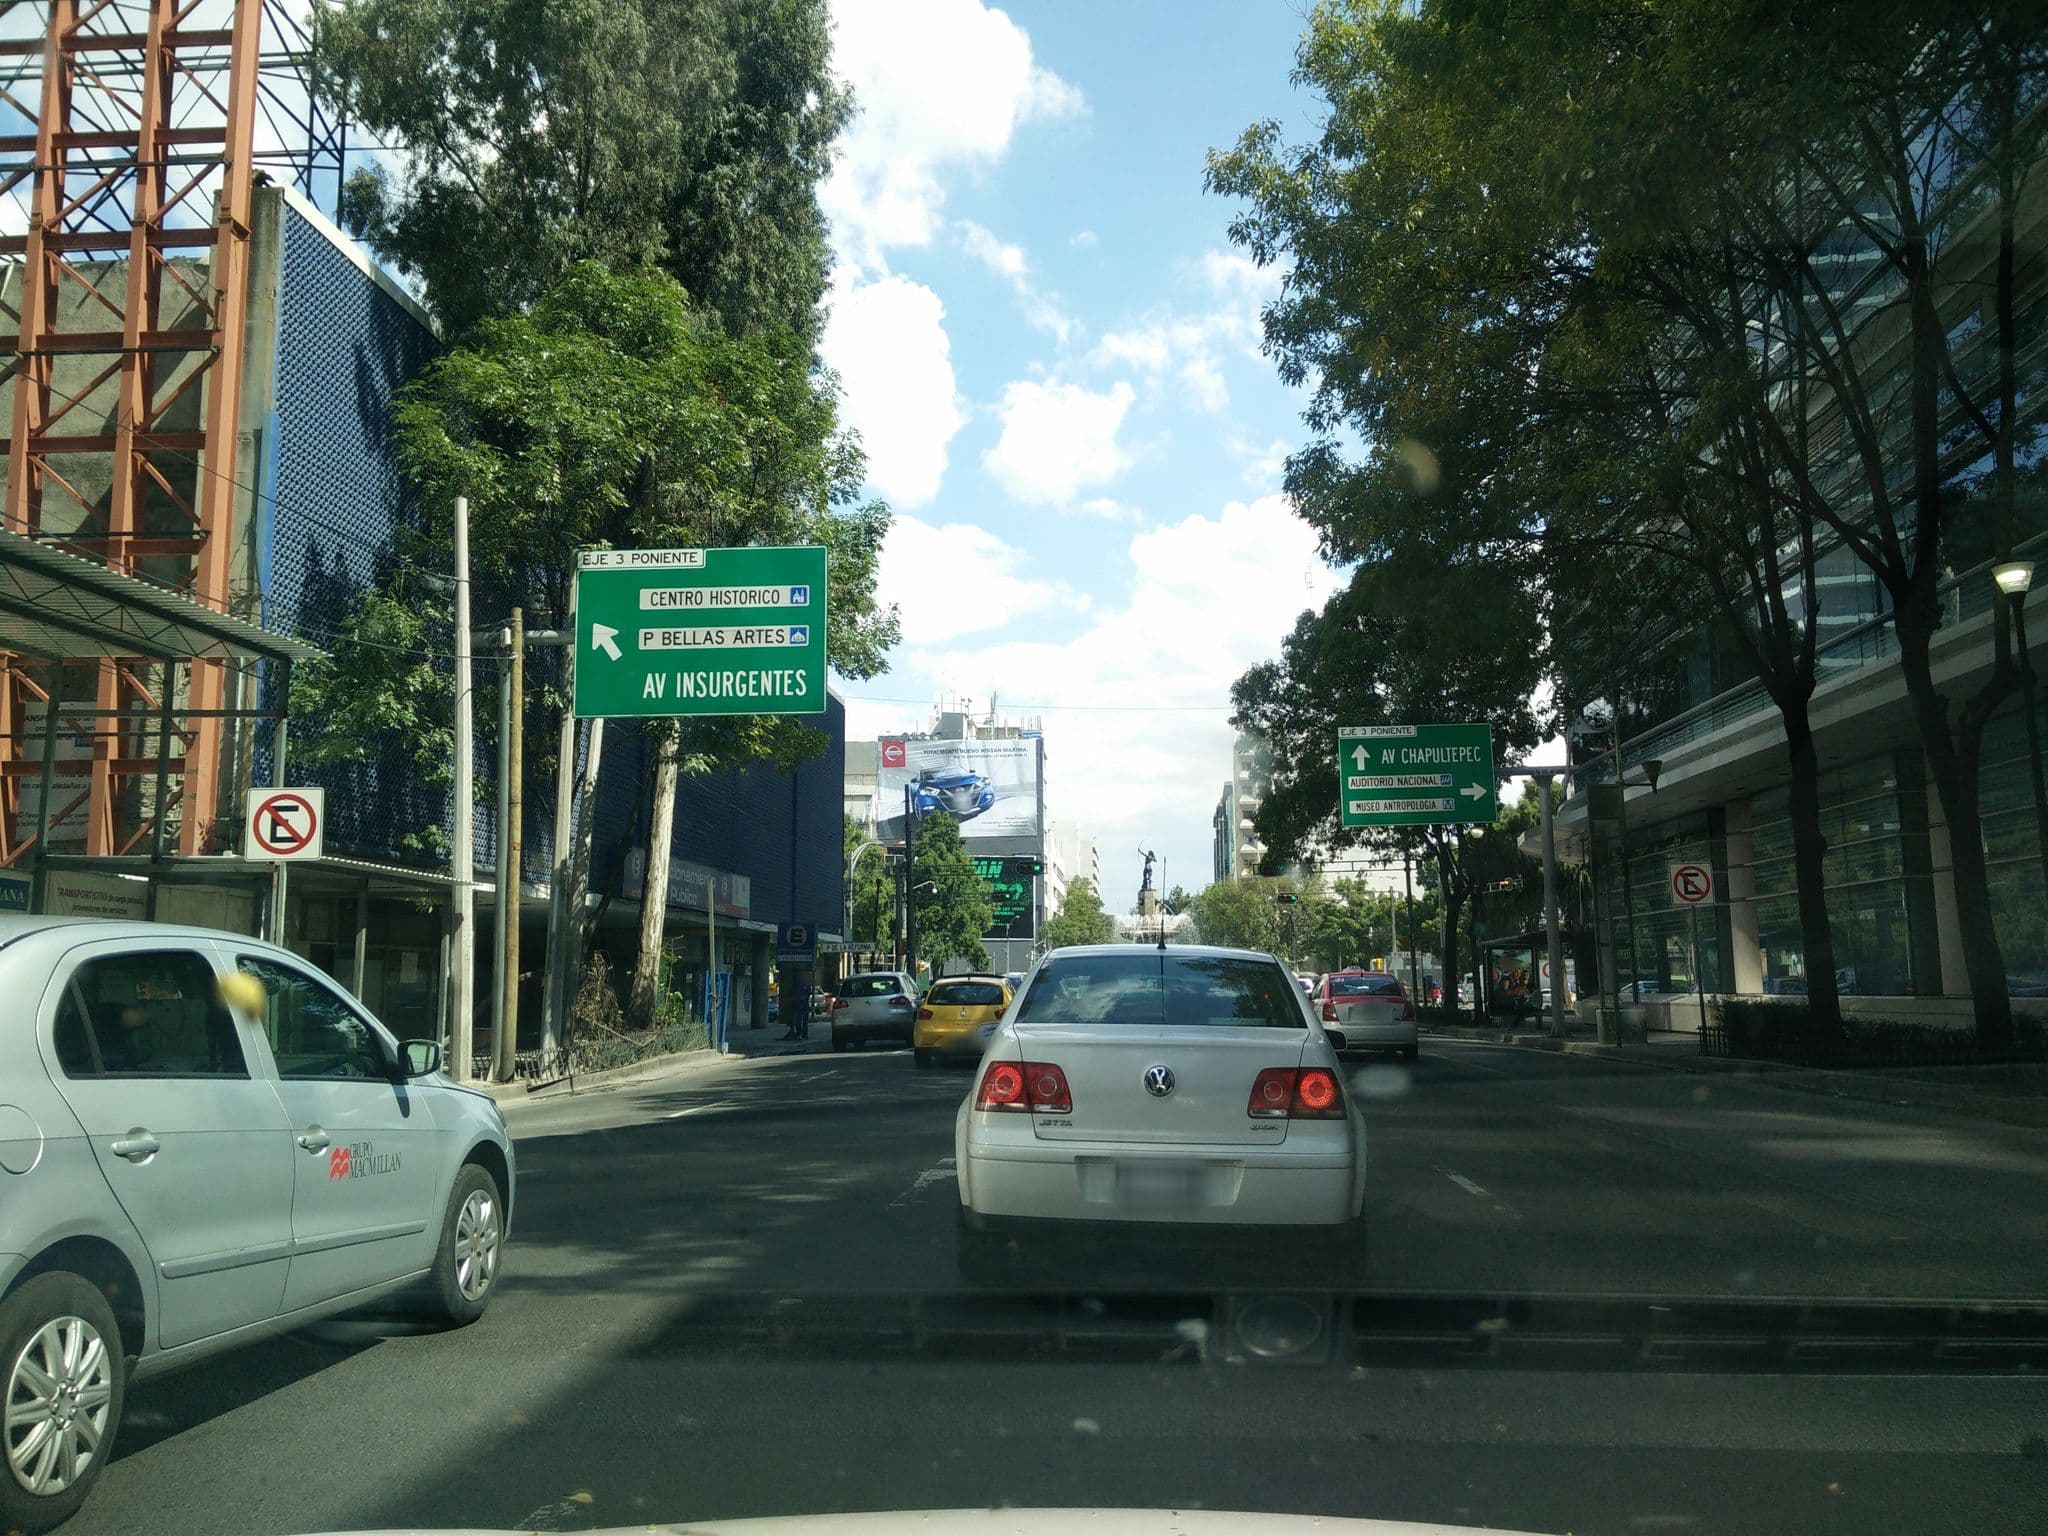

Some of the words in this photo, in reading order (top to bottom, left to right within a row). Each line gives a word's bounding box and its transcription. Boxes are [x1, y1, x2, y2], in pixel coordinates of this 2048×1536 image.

[582, 553, 608, 565] EJE
[615, 554, 624, 565] 3
[631, 552, 698, 565] PONIENTE
[650, 590, 703, 607] CENTRO
[709, 589, 780, 606] HISTORICO
[643, 632, 654, 646] P
[662, 630, 724, 646] BELLAS
[733, 629, 785, 645] ARTES
[642, 672, 667, 699] AV
[676, 669, 807, 698] INSURGENTES
[1341, 728, 1358, 737] EJE
[1361, 728, 1367, 736] 3
[1371, 726, 1412, 735] PONIENTE
[1381, 749, 1395, 765] AV
[1402, 747, 1481, 764] CHAPULTEPEC
[1350, 776, 1394, 787] AUDITORIO
[1397, 775, 1439, 786] NACIONAL
[1356, 801, 1380, 812] MUSEO
[1383, 800, 1436, 811] ANTROPOLOGIA
[270, 806, 302, 843] E
[1682, 872, 1704, 895] E
[350, 1140, 373, 1159] GRUPO
[349, 1151, 402, 1180] MACMILLAN
